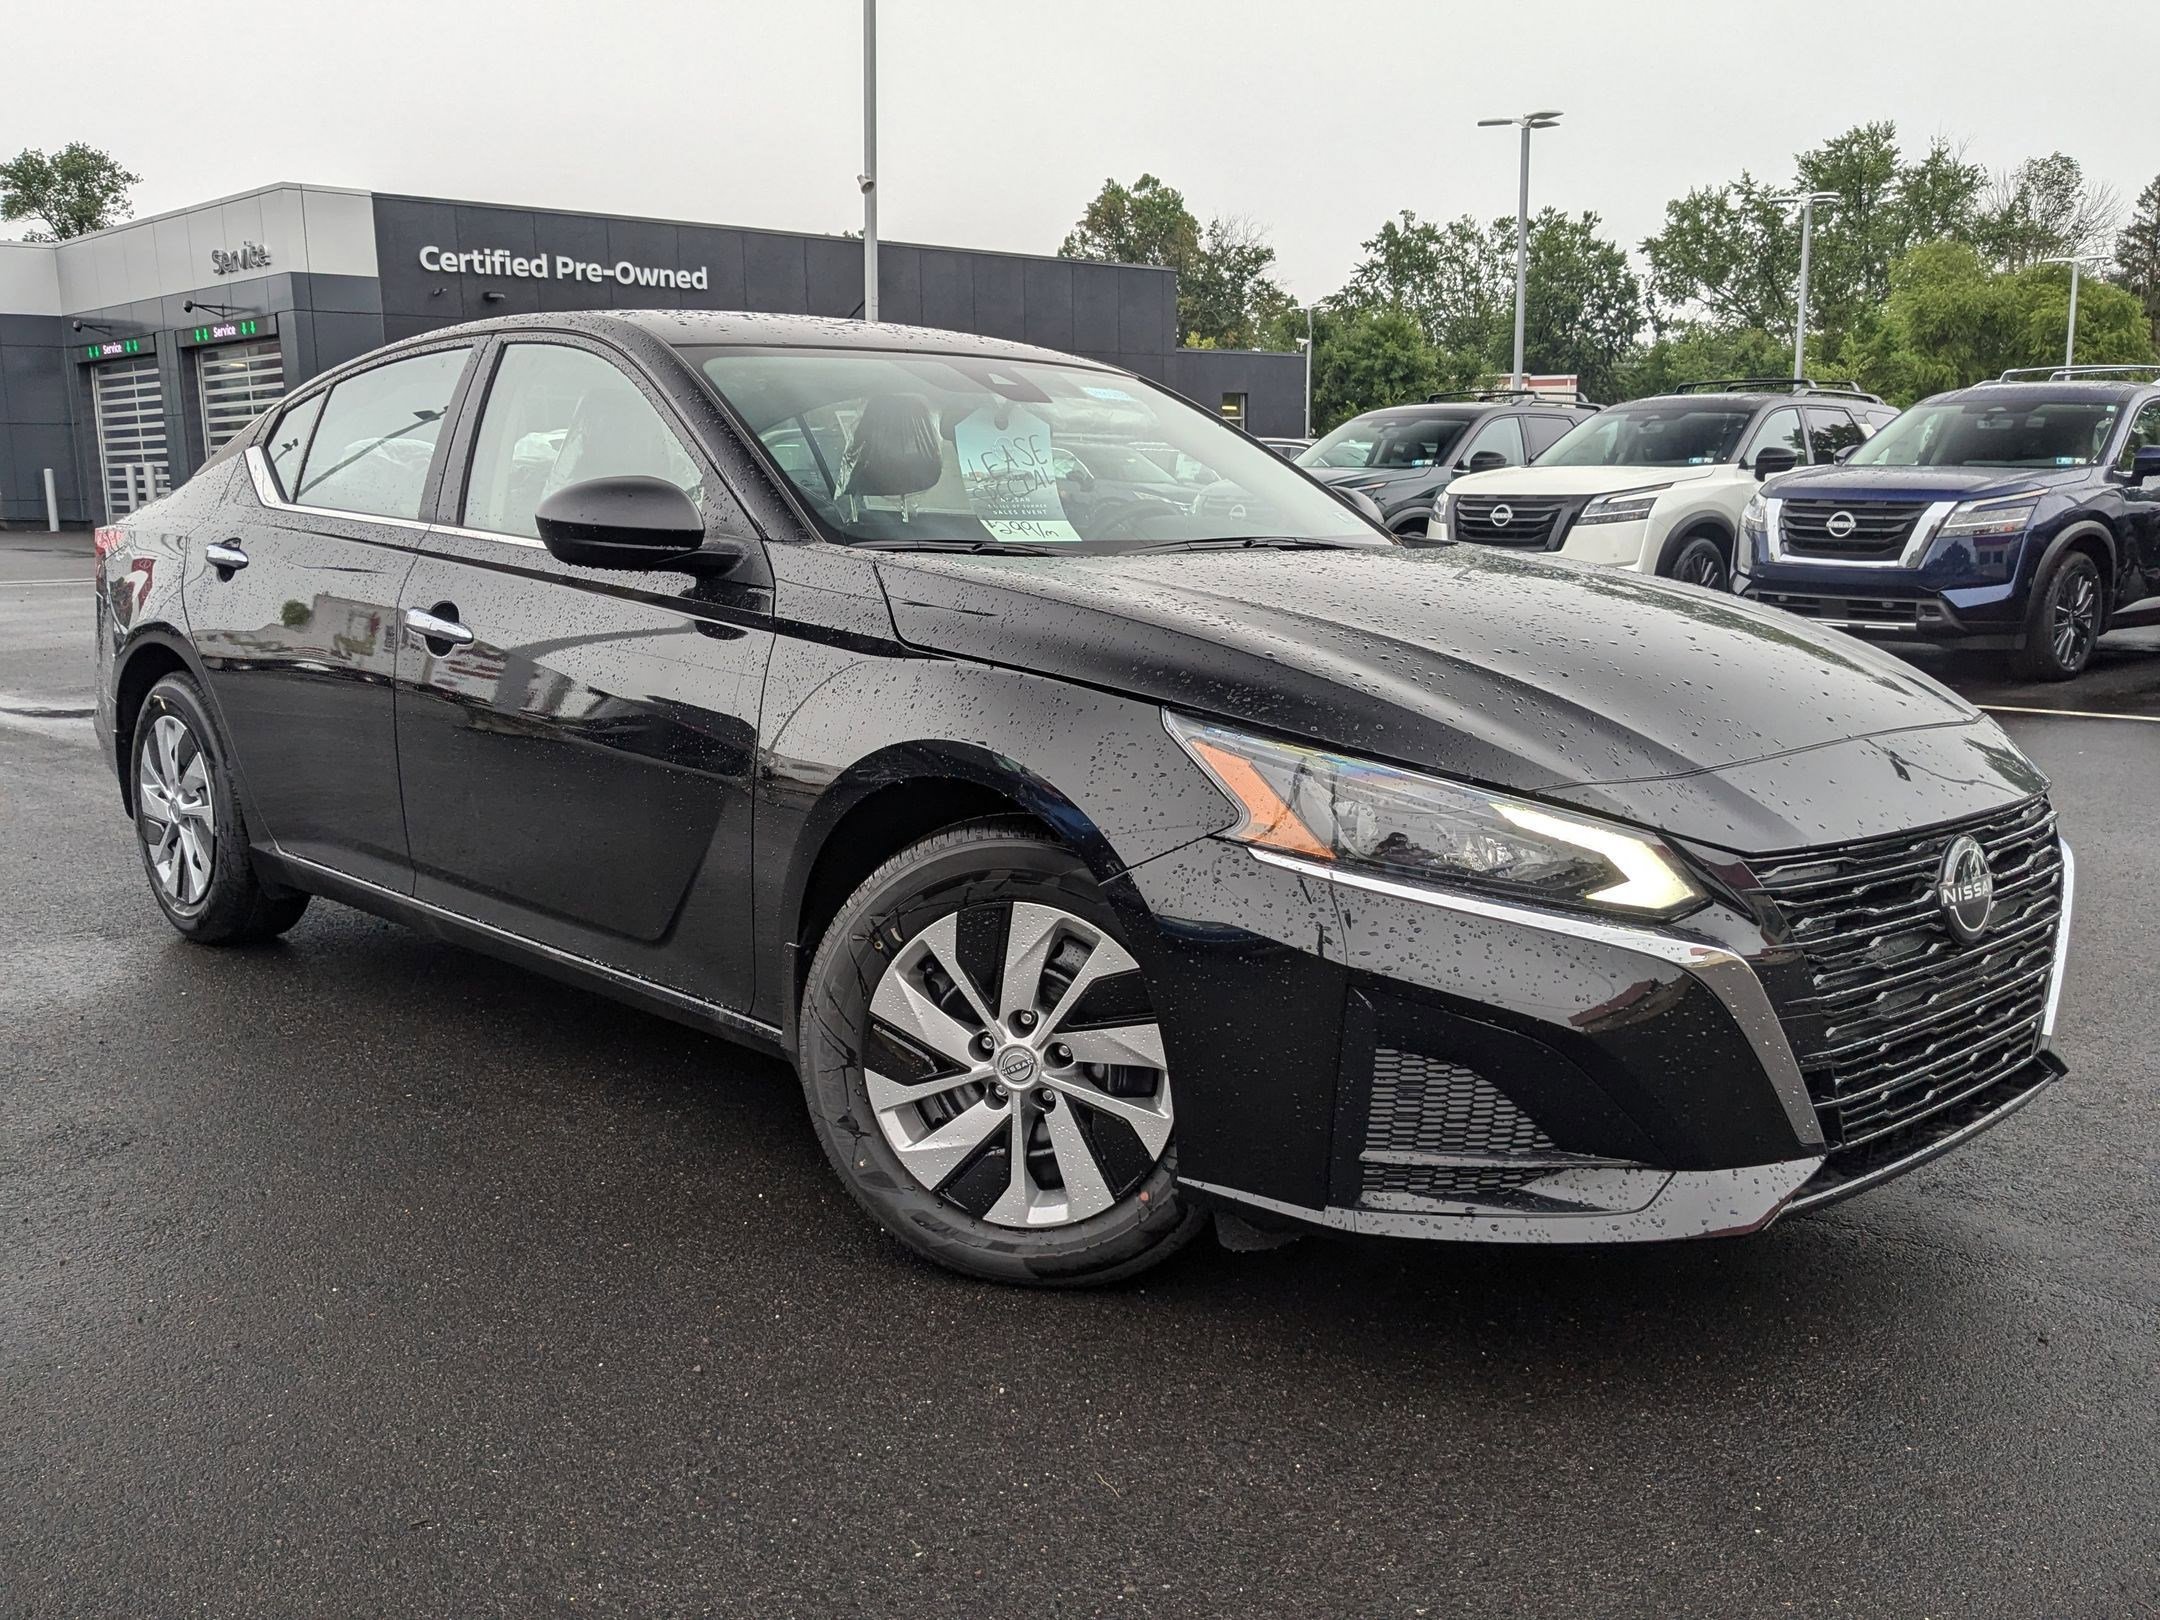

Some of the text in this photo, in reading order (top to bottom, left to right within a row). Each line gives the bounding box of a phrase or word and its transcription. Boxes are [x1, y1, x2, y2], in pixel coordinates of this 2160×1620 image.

[211, 240, 271, 275] Service
[419, 246, 708, 290] Certified Pre-Owned
[213, 322, 236, 338] Service
[102, 342, 123, 355] Service
[968, 434, 1048, 483] LEASE
[1942, 881, 1991, 904] NISSA
[1001, 1058, 1034, 1075] NISSAN
